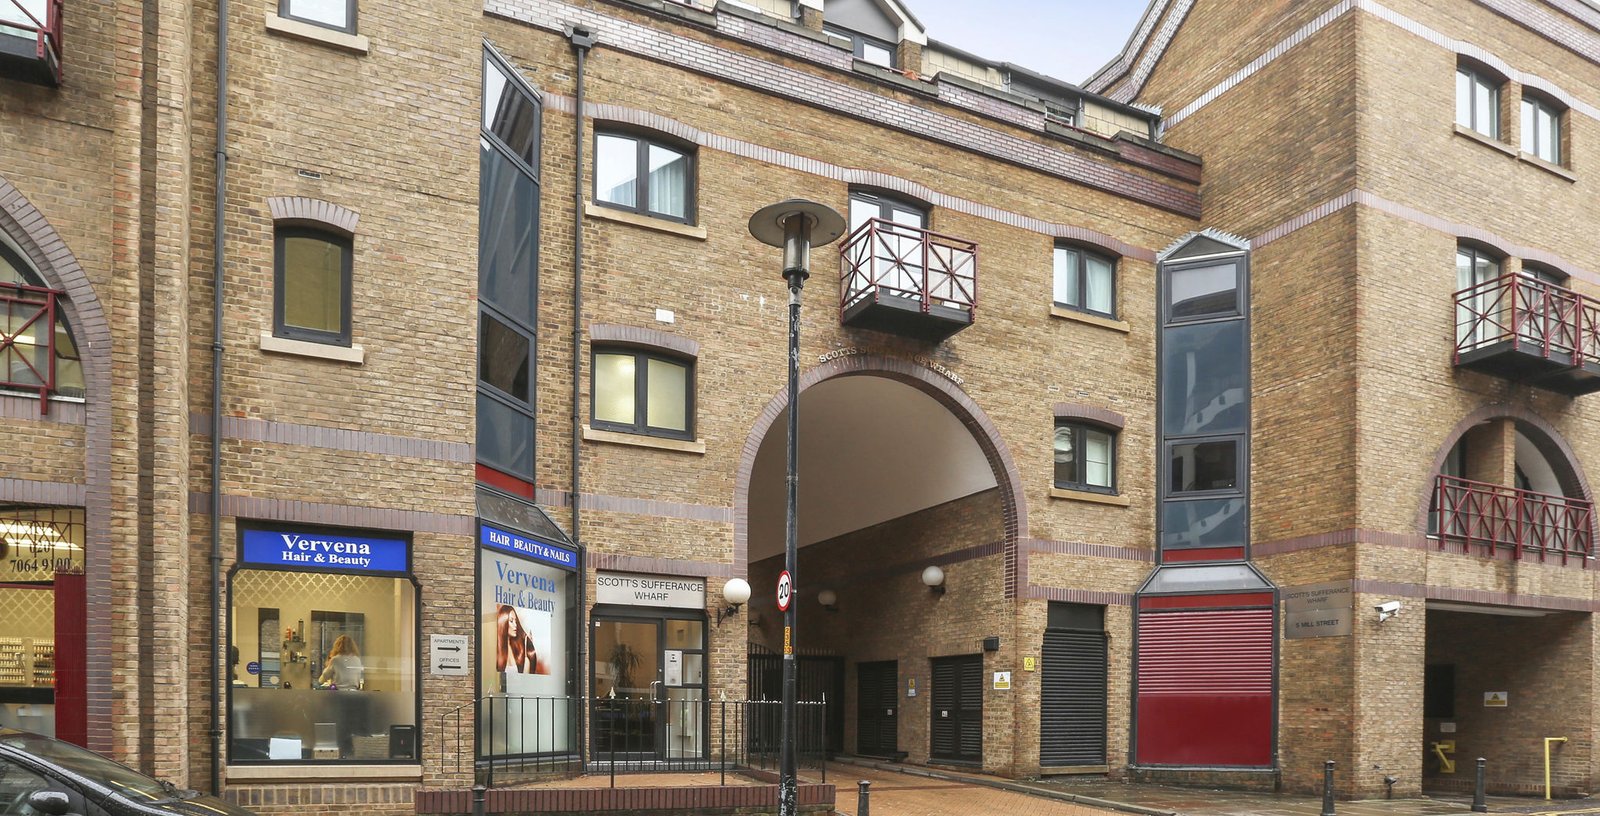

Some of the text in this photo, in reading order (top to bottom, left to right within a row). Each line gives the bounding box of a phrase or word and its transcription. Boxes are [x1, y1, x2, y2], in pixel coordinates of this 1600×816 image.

[819, 346, 858, 363] SCOTTS
[929, 360, 965, 386] WHARF
[281, 534, 370, 554] Vervena
[489, 531, 570, 563] HAIR BEAUTY & NAILS
[10, 557, 72, 573] 7064 9100
[282, 551, 371, 567] Hair & Beauty
[495, 560, 555, 593] Vervena
[597, 577, 703, 592] SCOTT'S SUFFERANCE
[634, 591, 669, 601] WHARF
[779, 581, 789, 600] 20
[495, 585, 556, 618] Hair & Beauty
[1315, 619, 1339, 627] STREET
